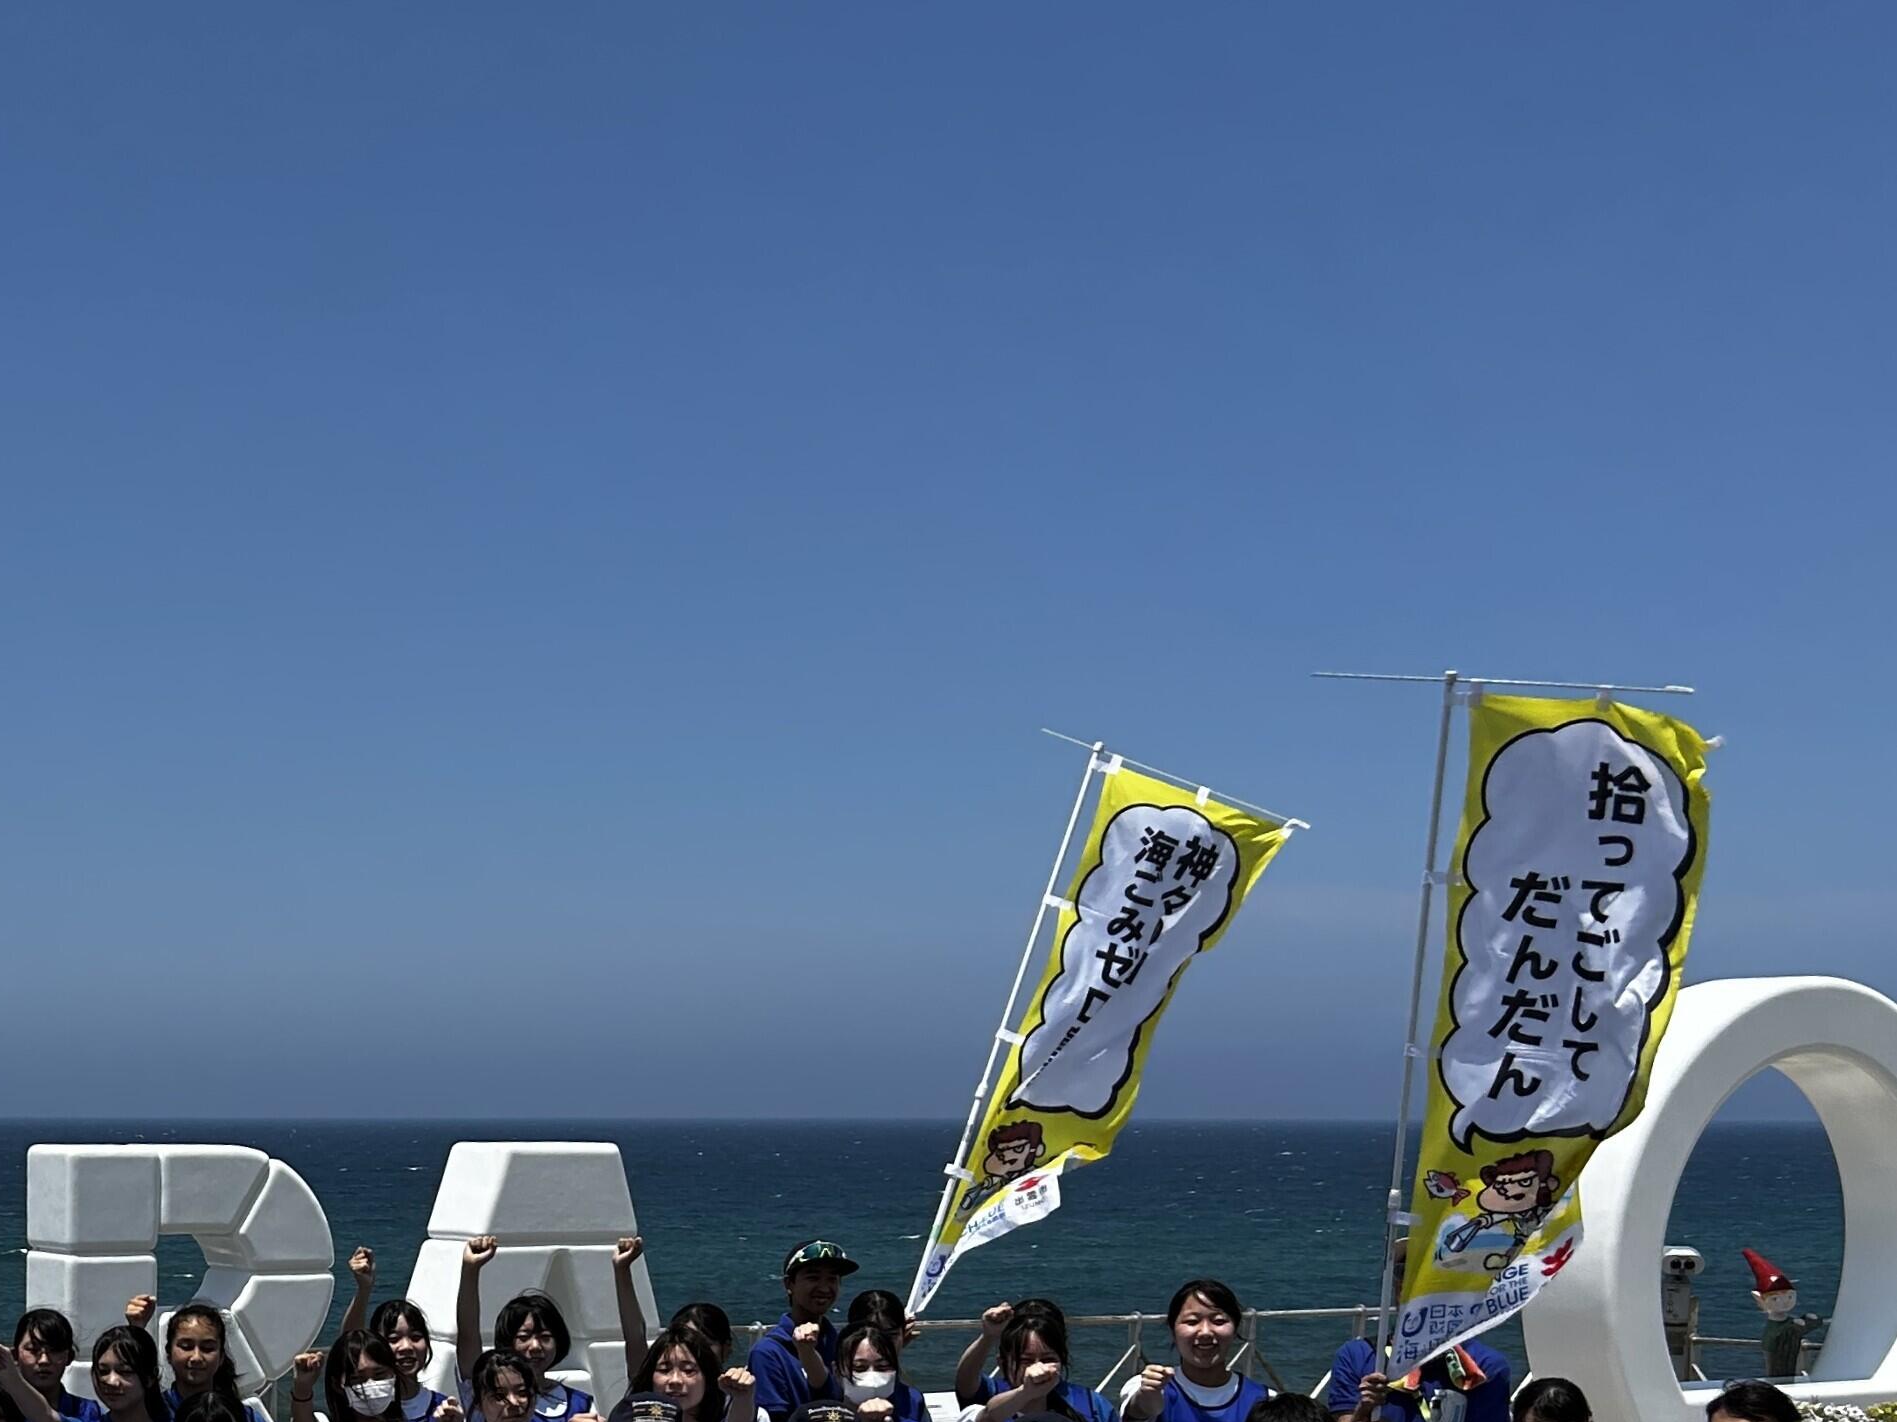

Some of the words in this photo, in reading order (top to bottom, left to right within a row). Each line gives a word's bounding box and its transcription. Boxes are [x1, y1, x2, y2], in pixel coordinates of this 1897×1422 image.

[1487, 871, 1571, 1100] だんだん
[1562, 761, 1652, 1082] 拾ってごして
[1429, 1304, 1463, 1319] 日本
[1486, 1286, 1529, 1314] BLUE
